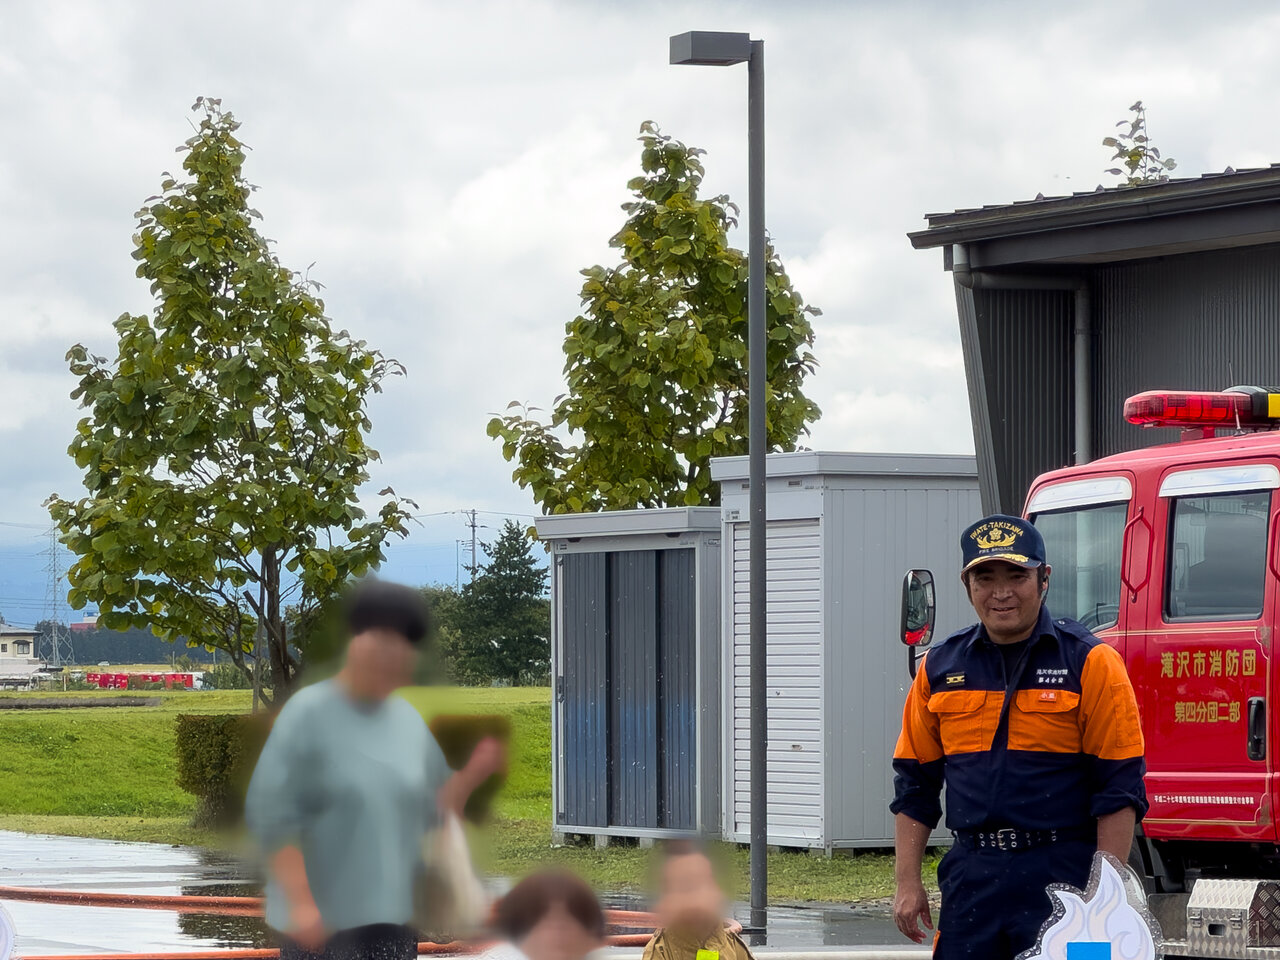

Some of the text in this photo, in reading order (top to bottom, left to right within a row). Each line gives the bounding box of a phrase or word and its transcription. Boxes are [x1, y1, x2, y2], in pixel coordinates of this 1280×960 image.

[1160, 648, 1257, 679] 滝沢市消防団
[1174, 701, 1241, 723] 第四分団二部
